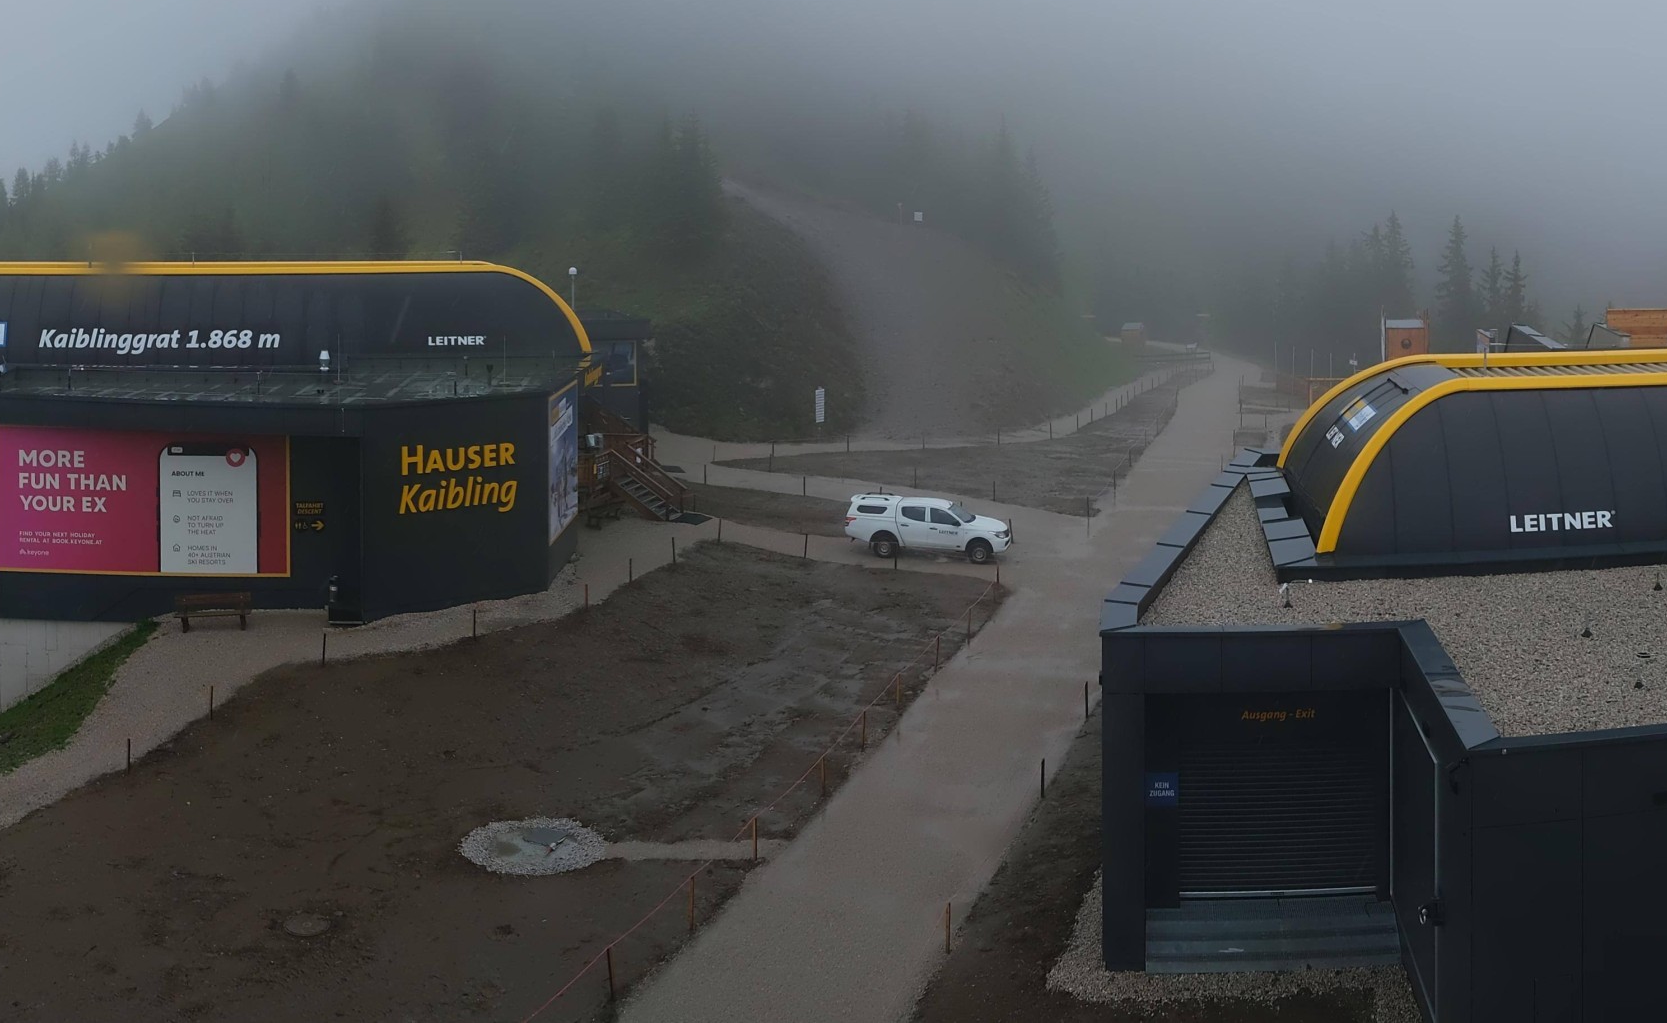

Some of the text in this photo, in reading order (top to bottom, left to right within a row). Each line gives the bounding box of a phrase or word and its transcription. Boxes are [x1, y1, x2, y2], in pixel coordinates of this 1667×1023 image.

[38, 328, 281, 355] Kaiblinggrat 1.868 m
[428, 336, 485, 346] LEITNER
[18, 449, 85, 468] MORE
[401, 442, 516, 476] HAUSER
[18, 472, 127, 491] FUN THAN
[20, 495, 107, 513] YOUR EX
[399, 476, 518, 514] Kaibling
[1510, 510, 1613, 533] LEITNER
[27, 549, 49, 557] keyone
[1241, 710, 1287, 722] Ausgang
[1295, 708, 1316, 719] Exit
